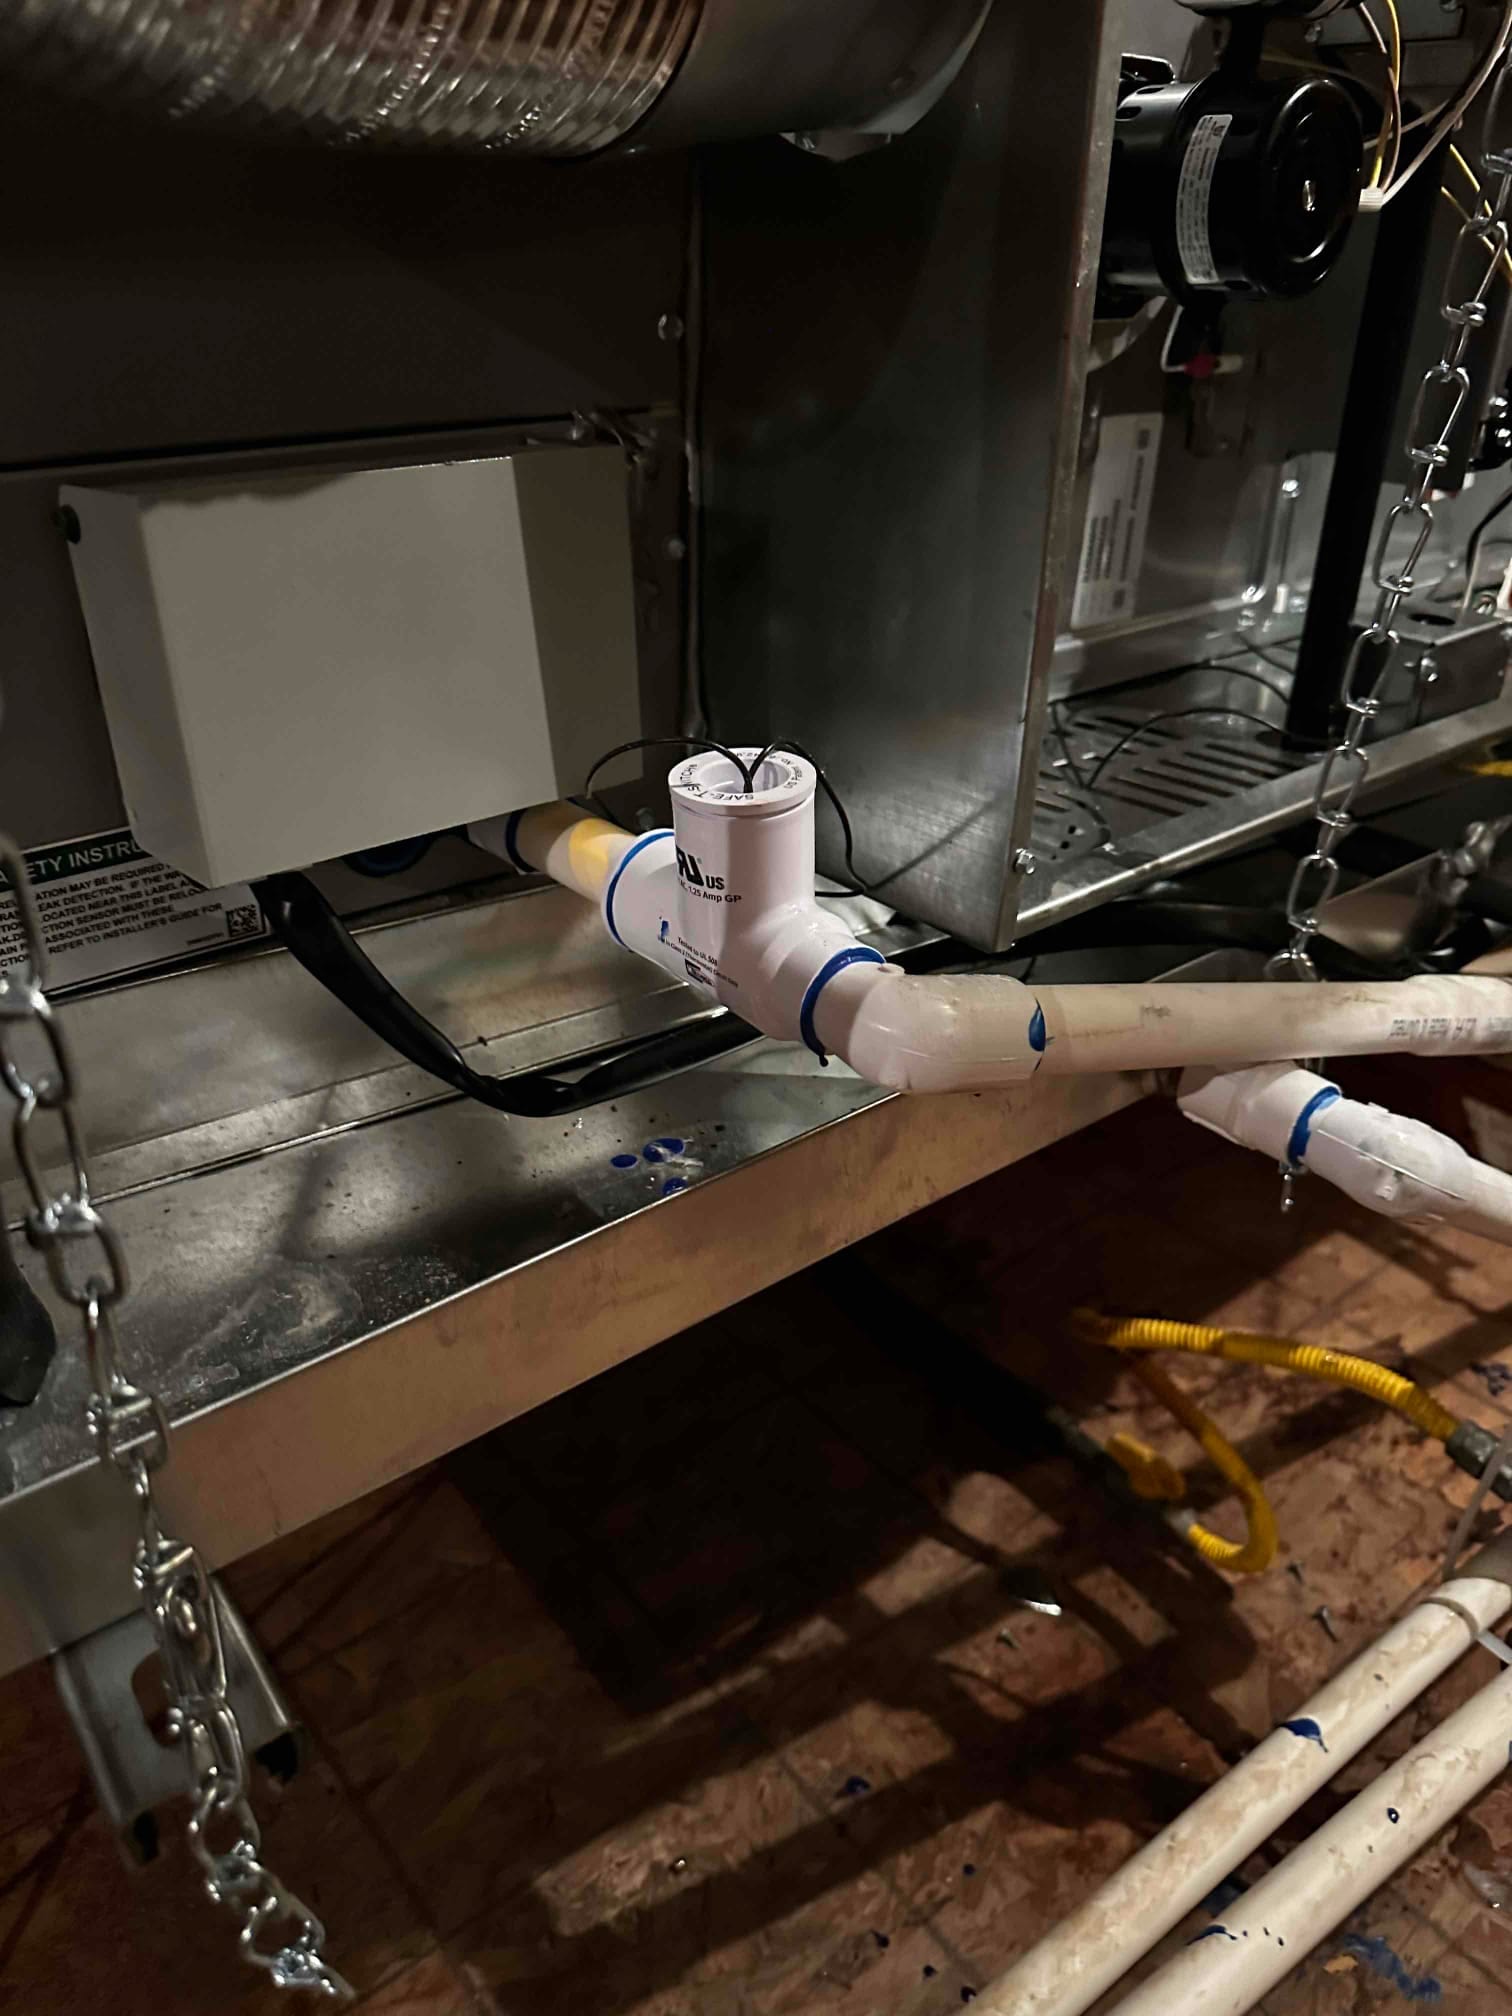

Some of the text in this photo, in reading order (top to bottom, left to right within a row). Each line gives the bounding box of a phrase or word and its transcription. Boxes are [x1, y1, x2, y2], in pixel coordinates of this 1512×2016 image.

[68, 840, 142, 868] INSTRU
[69, 880, 92, 892] MAY
[94, 876, 108, 887] BE
[111, 863, 165, 881] REQUIRED
[141, 874, 162, 885] THE
[705, 874, 725, 891] US
[42, 905, 86, 922] OCATED
[88, 896, 117, 910] NEAR
[119, 890, 142, 901] THIS
[144, 883, 177, 896] LABEL
[76, 907, 120, 925] SENSOR
[121, 900, 149, 912] MUST
[152, 896, 166, 905] BE
[702, 891, 723, 904] Amp
[724, 894, 743, 904] GP
[45, 921, 111, 944] ASSOCIATED
[112, 914, 139, 926] WITH
[48, 939, 84, 954] REFER
[86, 934, 101, 946] TO
[201, 902, 222, 914] FOR
